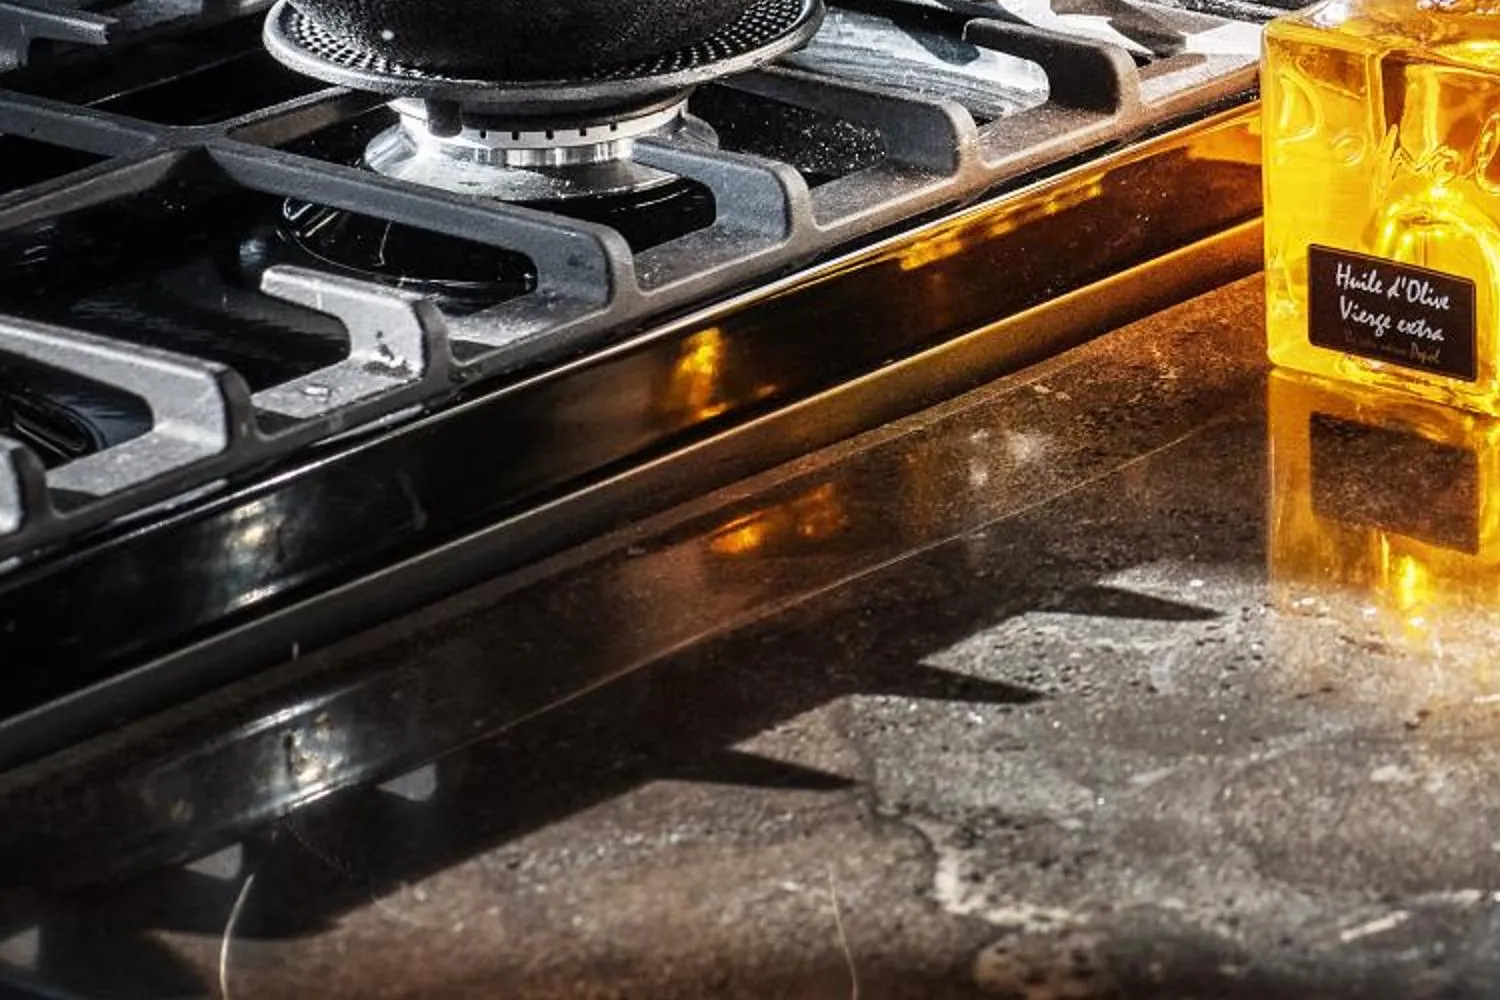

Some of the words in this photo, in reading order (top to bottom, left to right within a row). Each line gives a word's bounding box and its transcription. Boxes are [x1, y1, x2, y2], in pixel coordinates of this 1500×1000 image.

[1335, 262, 1383, 294] Huile
[1387, 276, 1451, 311] d'Olive
[1340, 295, 1391, 337] Vierge
[1396, 317, 1445, 342] extra
